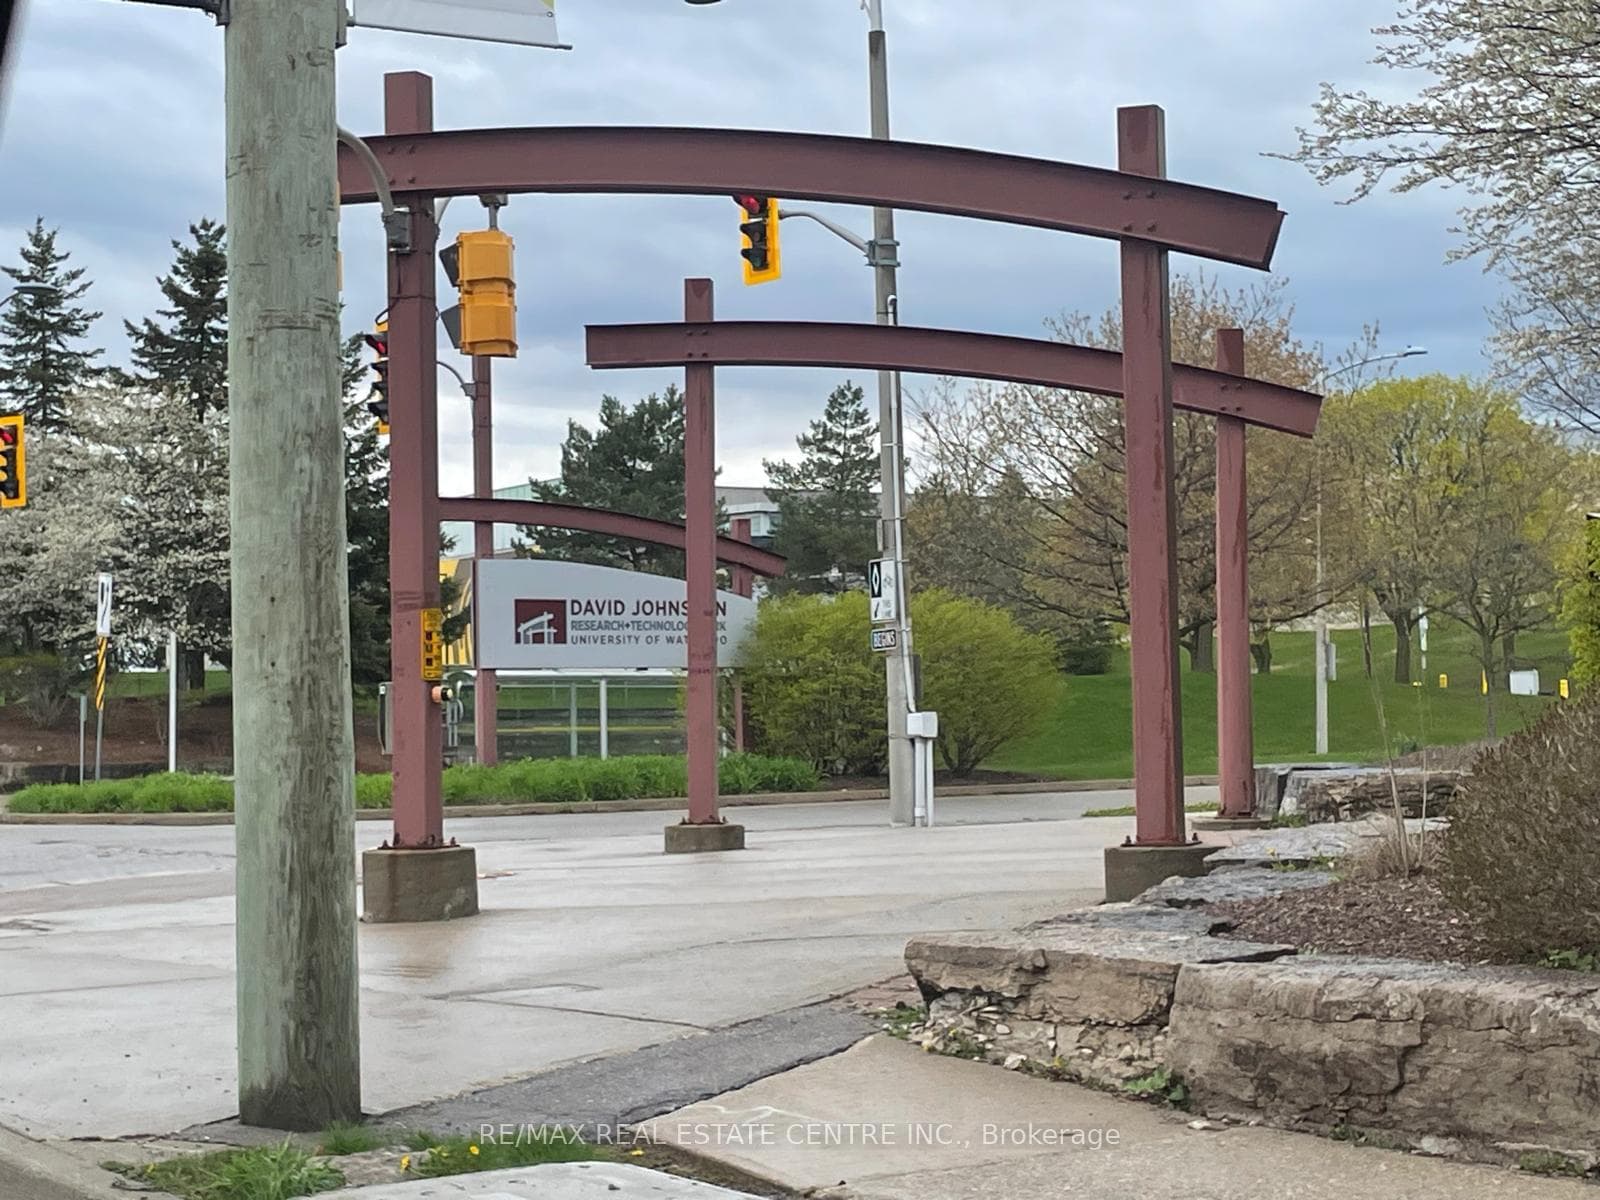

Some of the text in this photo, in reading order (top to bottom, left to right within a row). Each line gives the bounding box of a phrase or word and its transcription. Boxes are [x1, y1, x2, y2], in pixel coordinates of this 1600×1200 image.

[570, 600, 727, 616] DAVID JOHNSN
[571, 635, 640, 645] UNIVERSITY
[645, 635, 660, 645] OF
